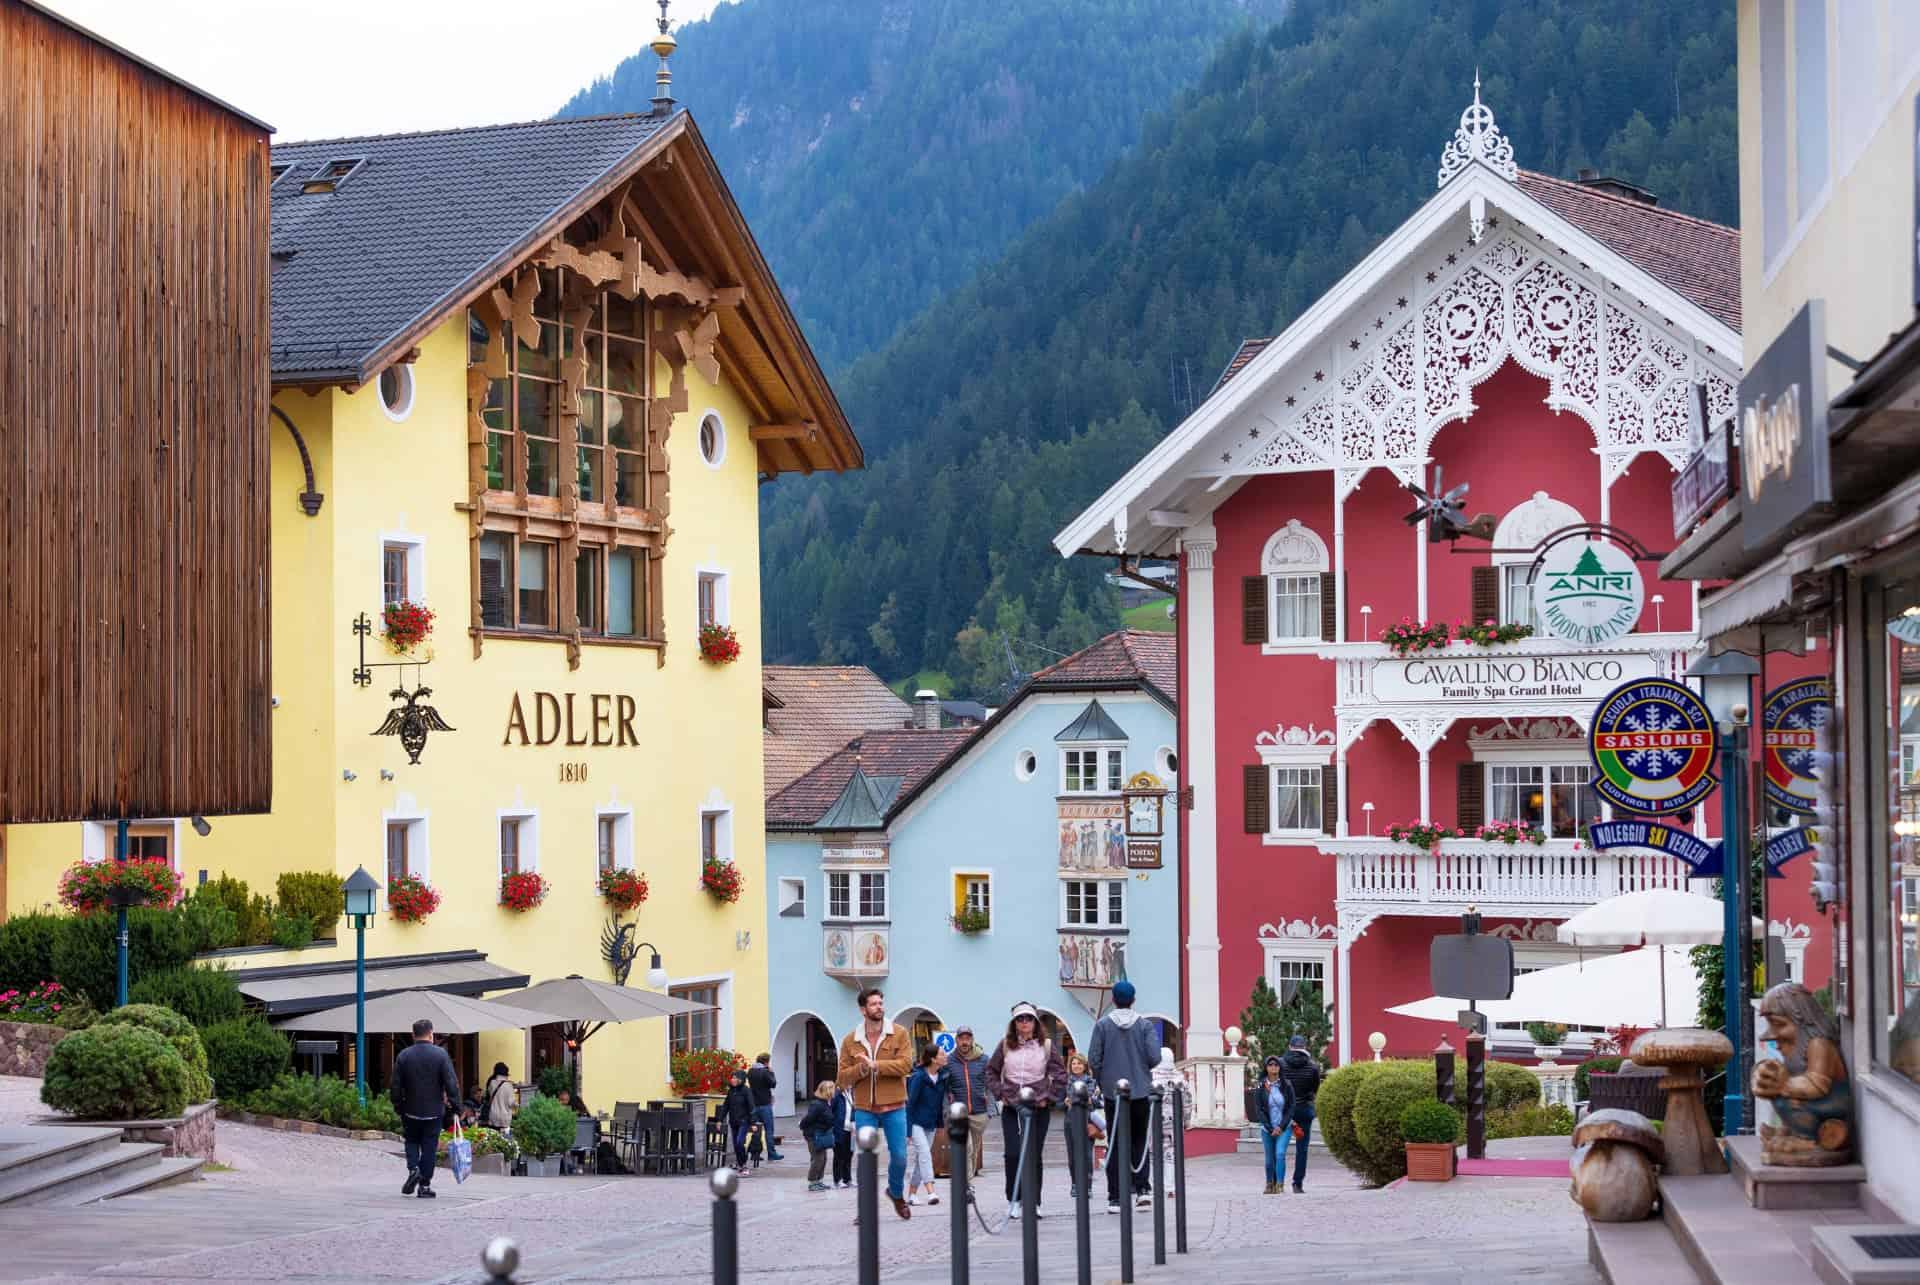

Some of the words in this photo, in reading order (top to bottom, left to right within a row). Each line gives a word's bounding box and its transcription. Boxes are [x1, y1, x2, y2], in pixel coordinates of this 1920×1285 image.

[1549, 576, 1632, 591] ANRI
[1545, 604, 1637, 645] WOODCARVINGS
[1442, 685, 1481, 699] Family
[1484, 686, 1505, 698] Spa
[1509, 684, 1547, 697] Grand
[1550, 684, 1582, 696] Hotel
[1603, 692, 1637, 726] SCUOLA
[1640, 686, 1687, 707] ITALIANA
[1687, 705, 1704, 723] SCI
[502, 690, 641, 748] ADLER
[1604, 733, 1703, 748] SASLONG
[559, 762, 588, 783] 1810
[1663, 796, 1685, 809] ALTO
[1596, 824, 1646, 846] NOLEGGIO
[1648, 826, 1669, 848] SKI
[1668, 831, 1710, 865] VERLEIH
